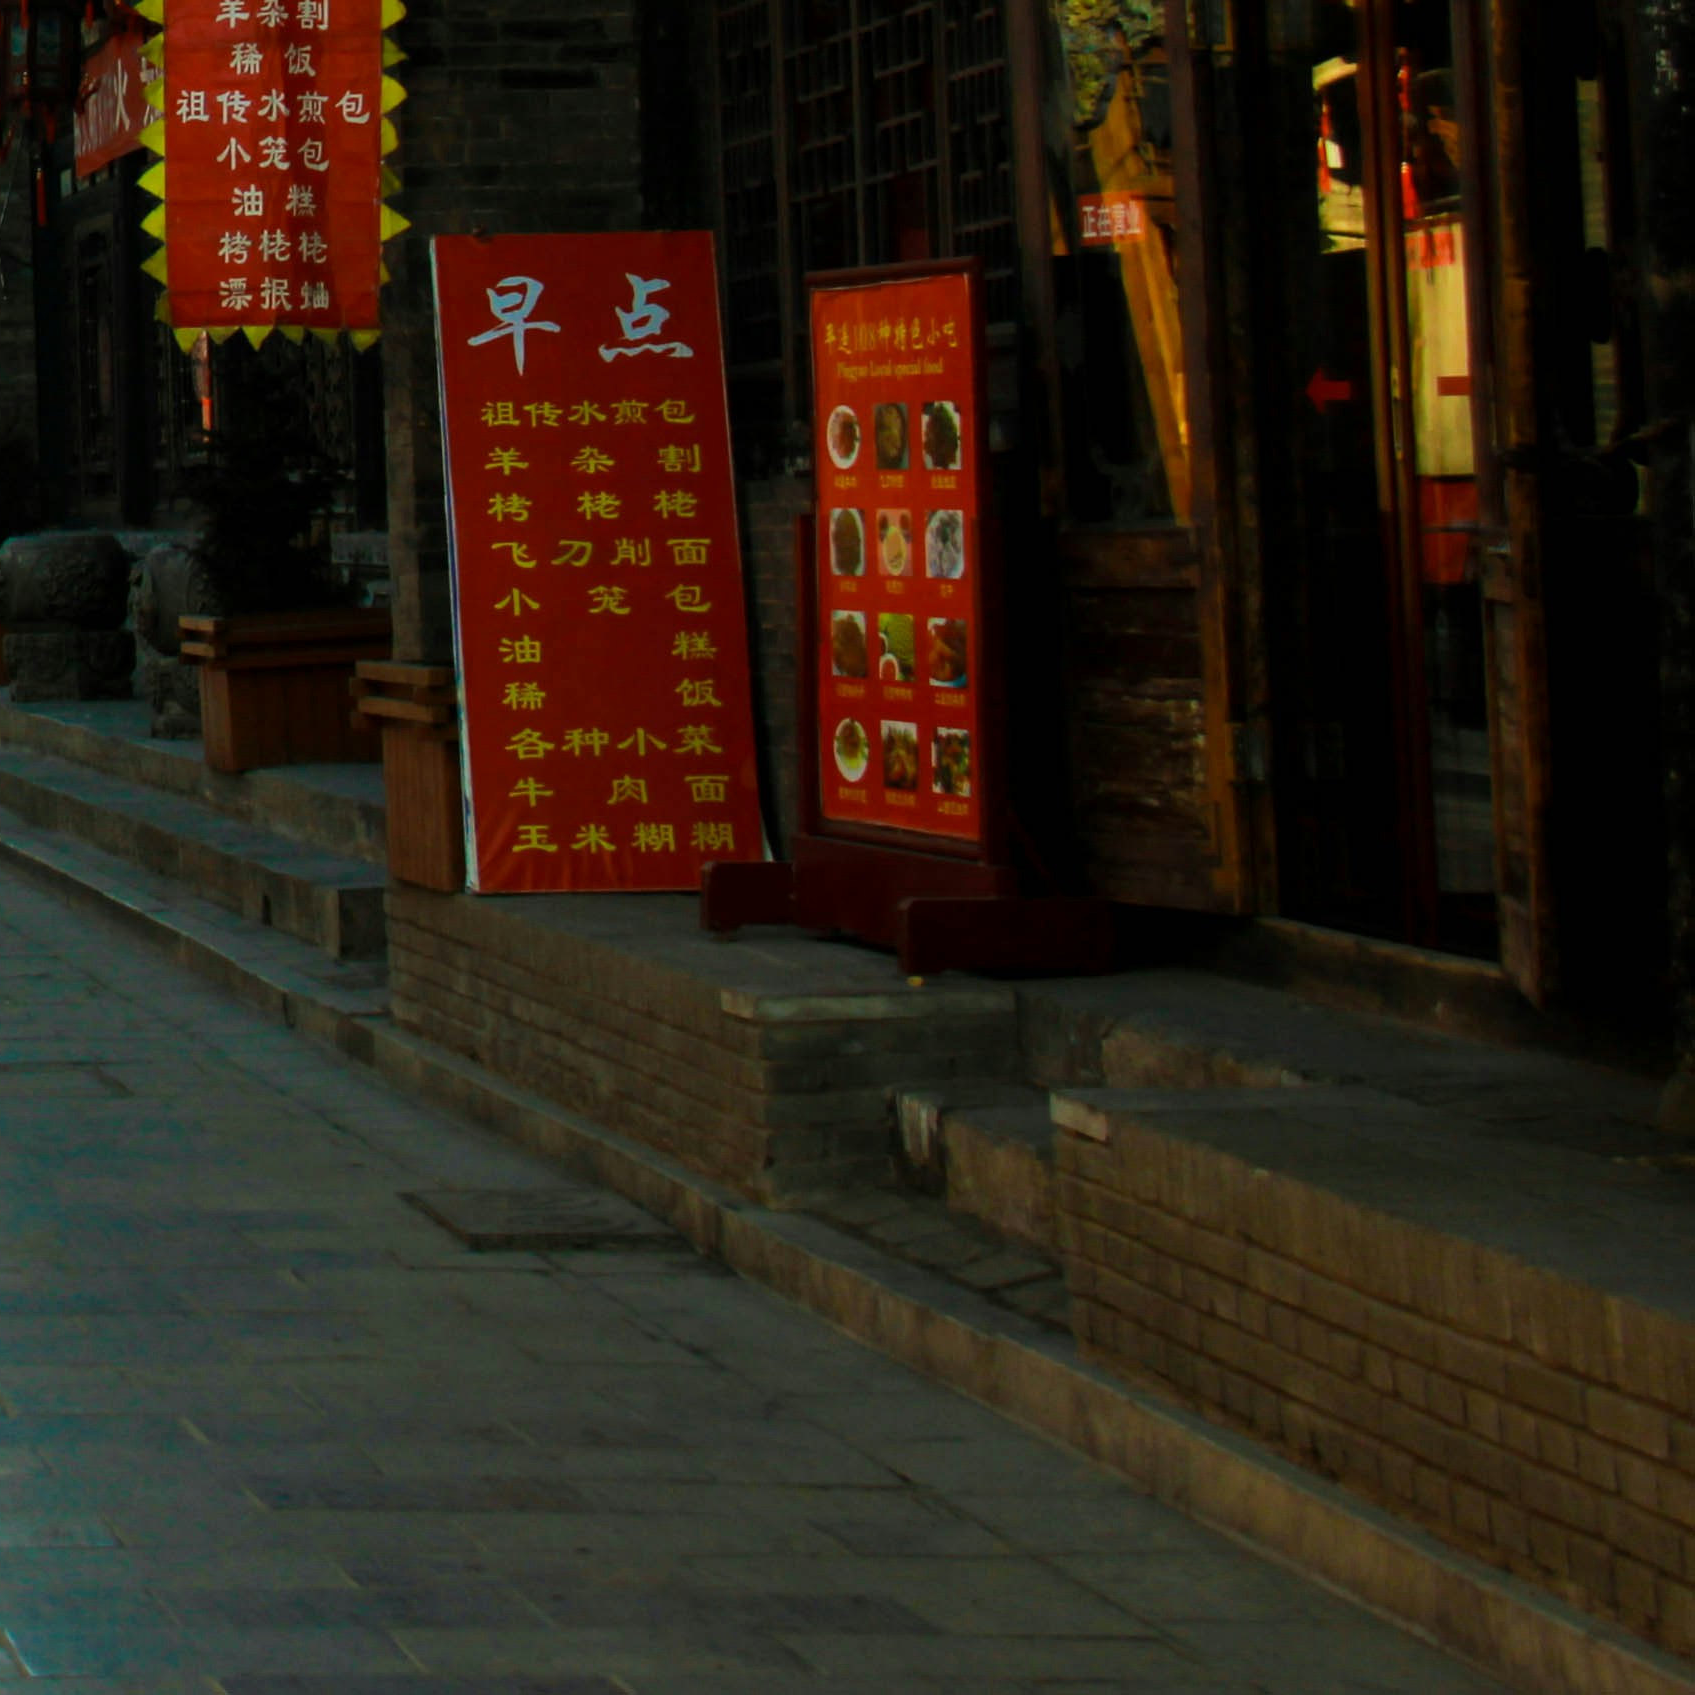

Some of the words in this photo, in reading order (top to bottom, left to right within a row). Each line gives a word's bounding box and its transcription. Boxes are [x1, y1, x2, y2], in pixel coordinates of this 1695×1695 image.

[229, 42, 316, 77] 稀饭
[176, 89, 370, 124] 祖传水煎包
[216, 136, 329, 171] 小笼包
[231, 184, 316, 217] 油糕
[468, 272, 693, 376] 早点
[481, 399, 695, 428] 祖传水煎包
[484, 444, 702, 475] 羊杂割
[491, 538, 711, 569] 飞刀削面
[493, 584, 712, 616] 小笼包
[505, 725, 723, 760] 各种小菜
[509, 775, 730, 807] 牛肉面
[512, 823, 735, 854] 玉米糊糊
